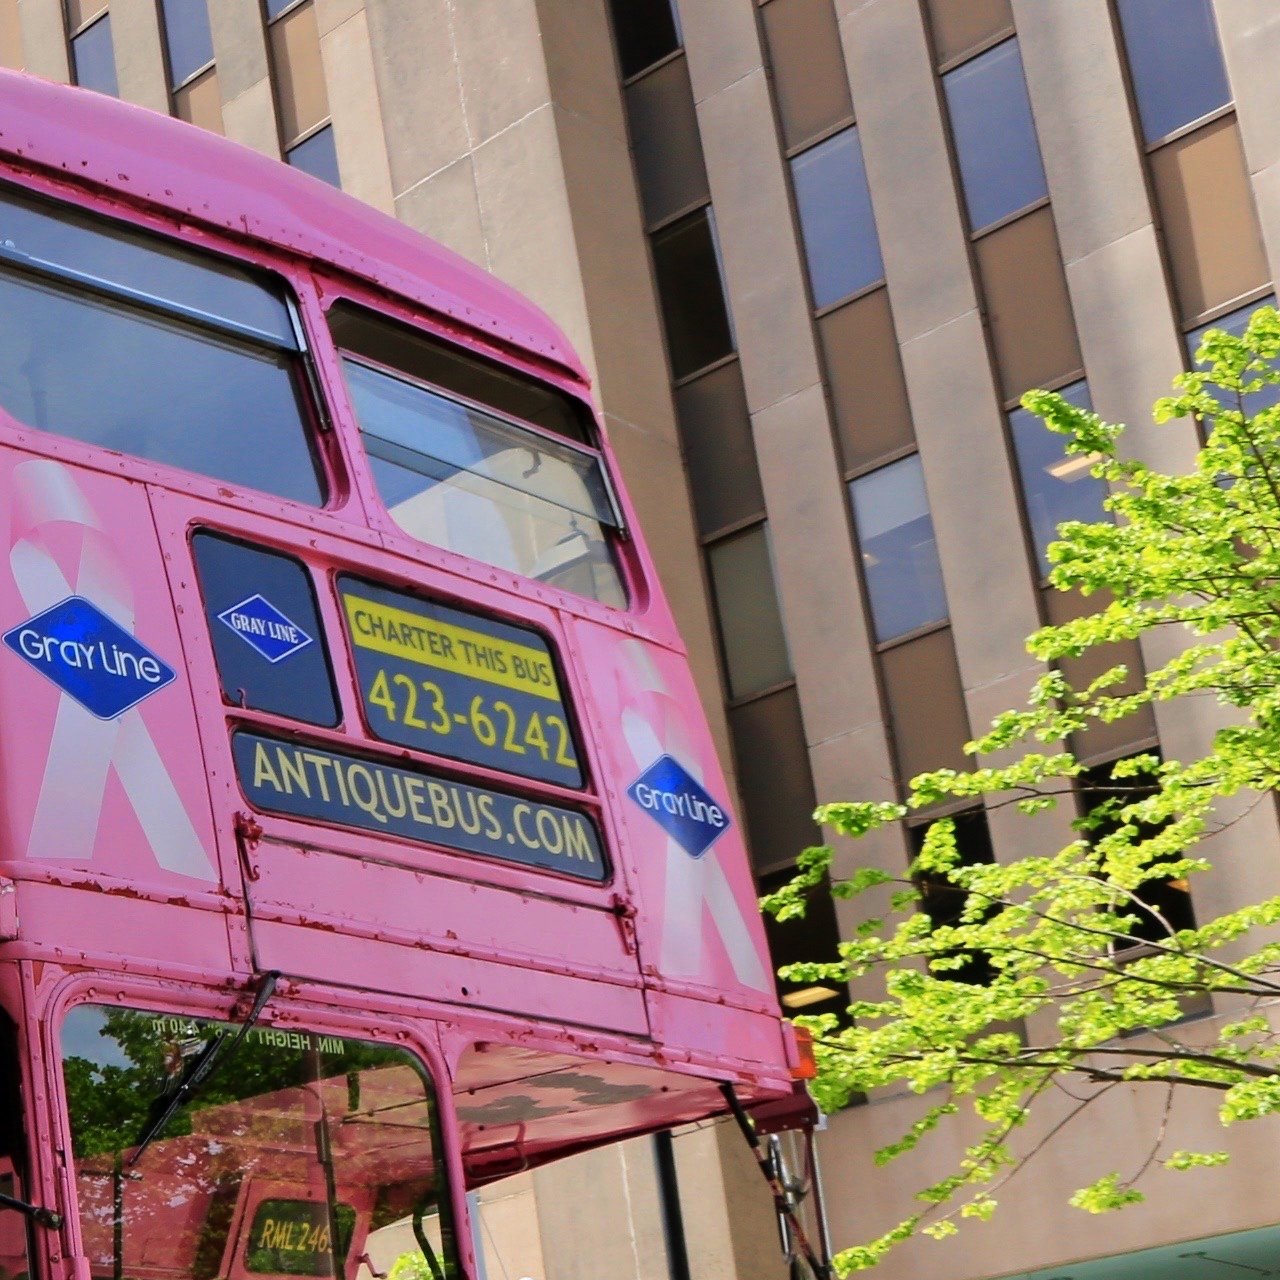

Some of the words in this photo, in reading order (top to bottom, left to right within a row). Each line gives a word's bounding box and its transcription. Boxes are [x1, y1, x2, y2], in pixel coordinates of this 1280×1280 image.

[231, 612, 269, 637] GRAY
[269, 623, 299, 644] LINE
[355, 609, 457, 660] CHARTER
[459, 640, 507, 675] THIS
[514, 657, 552, 687] BUS
[369, 669, 577, 769] 423-6242
[252, 741, 596, 863] ANTIQUEBUS.COM
[257, 1218, 294, 1251] RML
